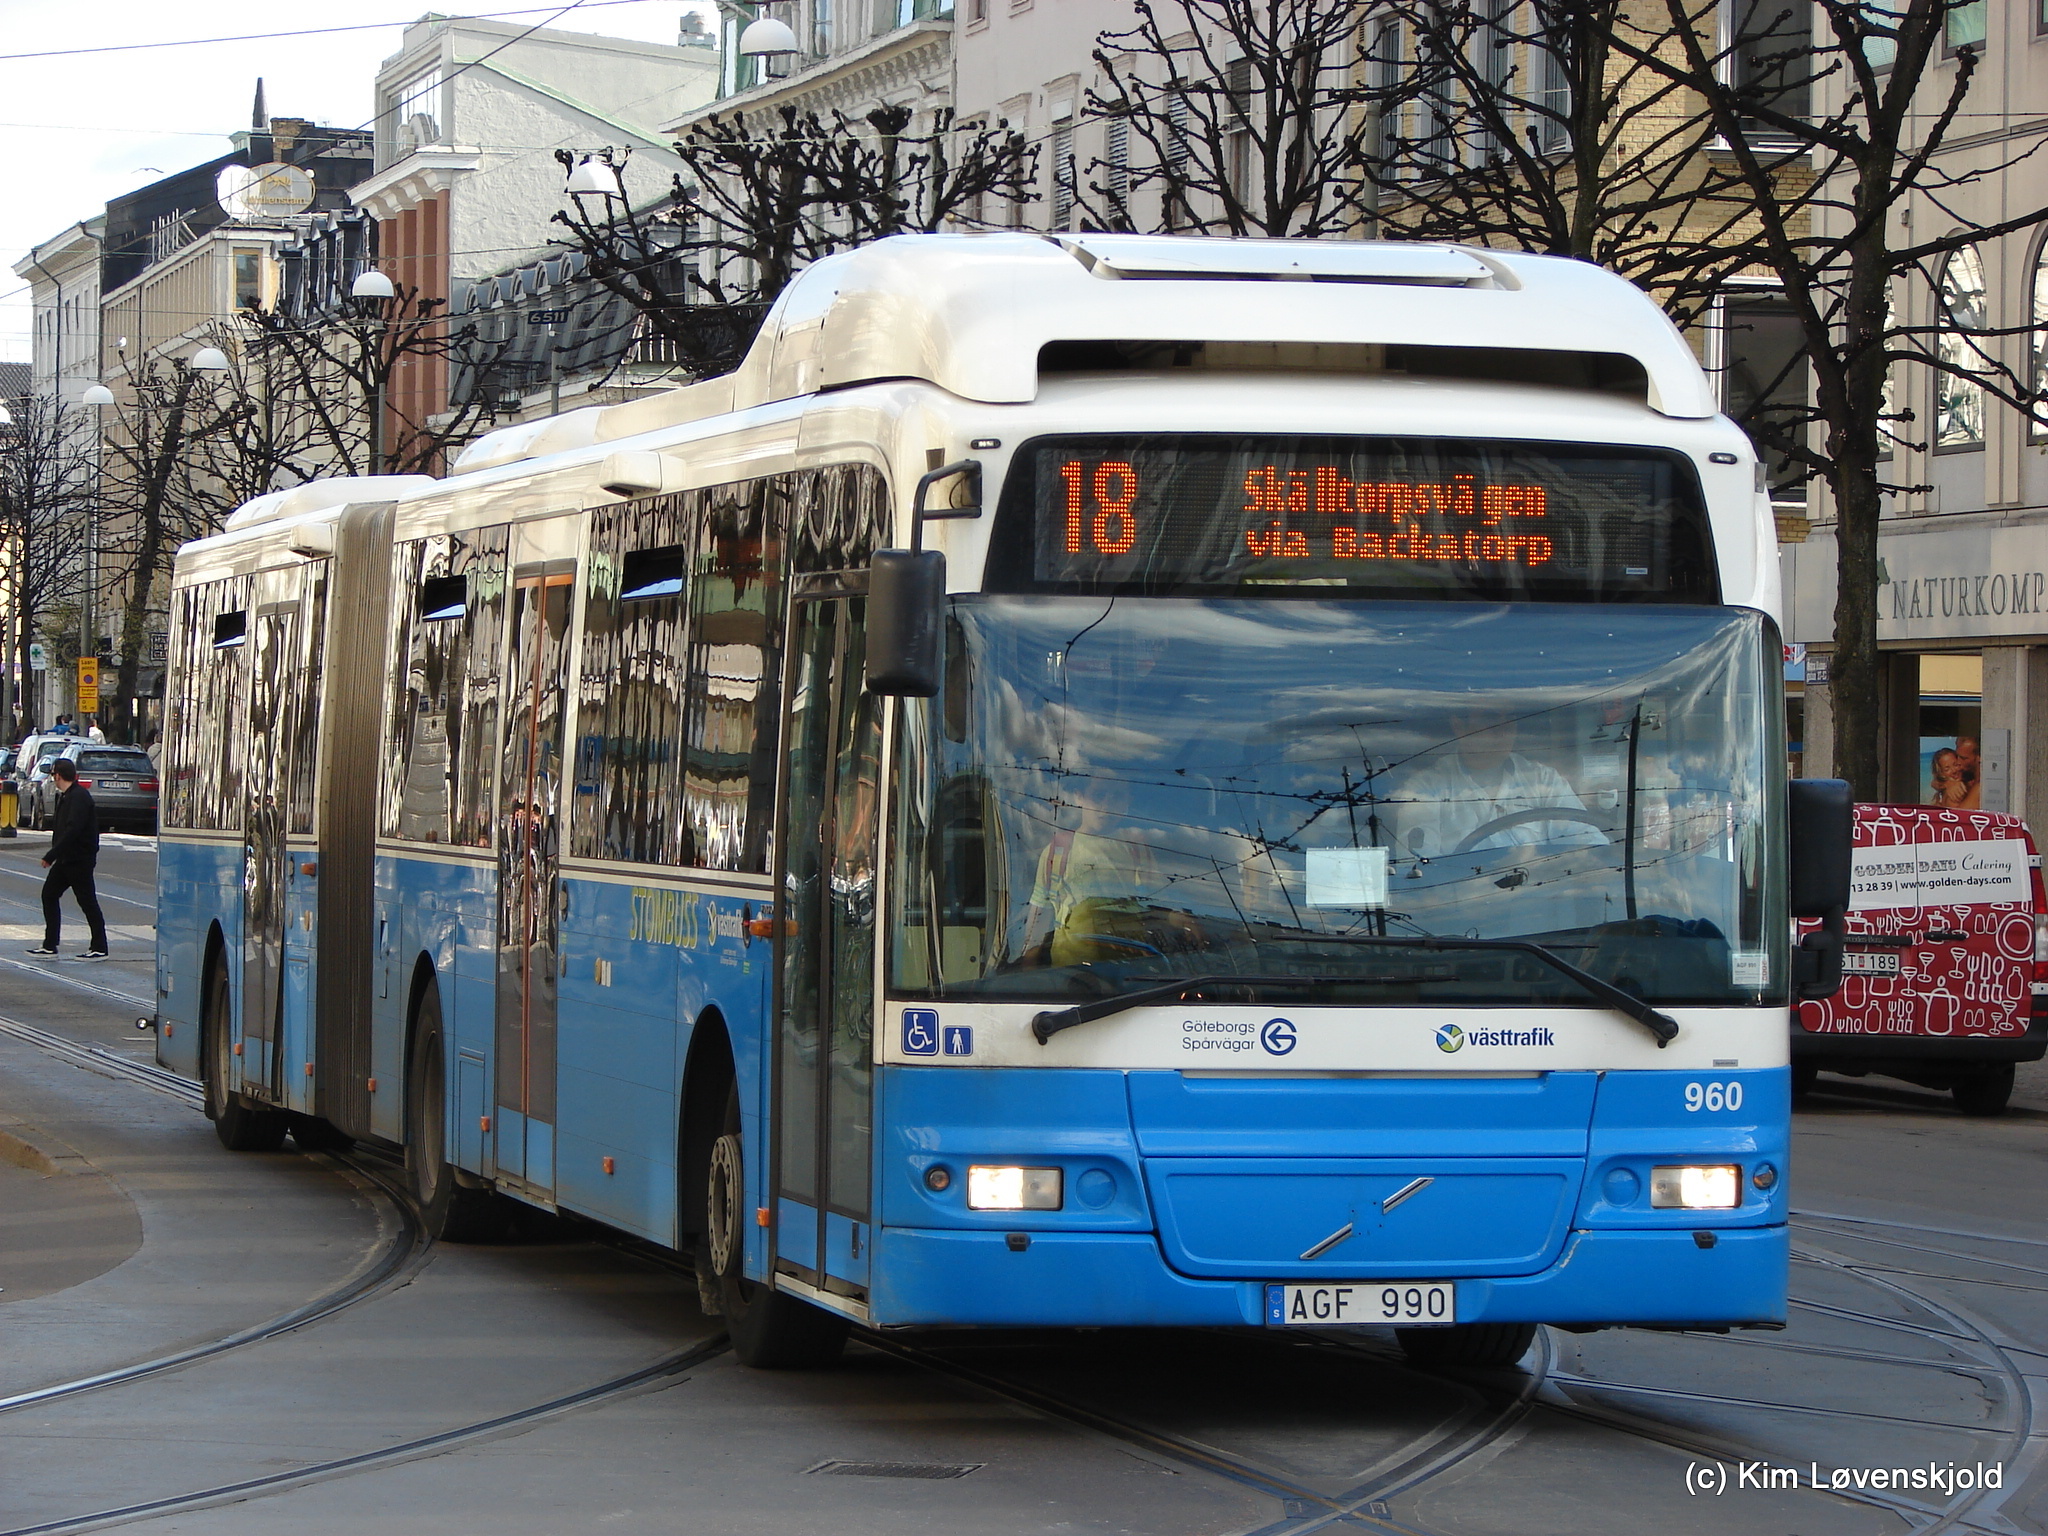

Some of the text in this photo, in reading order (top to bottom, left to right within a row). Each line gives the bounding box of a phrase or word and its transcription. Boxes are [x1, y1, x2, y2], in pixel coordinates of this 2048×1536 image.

[530, 311, 565, 322] 6511
[1061, 460, 1137, 554] 18
[1243, 465, 1547, 525] Skälltorpsvägen
[1246, 520, 1552, 566] via Backatorp
[1892, 573, 2048, 619] NATURKOMP
[1854, 853, 2012, 877] GOLDEN DAYS Catering
[1866, 882, 1879, 892] 28
[1880, 881, 1893, 891] 39
[1900, 875, 2012, 889] www.golden-days.com
[630, 886, 698, 950] STOMBUSS
[1870, 955, 1896, 969] 189
[1182, 1020, 1255, 1035] Göteborgs
[1468, 1027, 1555, 1047] västtrafik
[1182, 1037, 1255, 1052] Spårvägar
[1684, 1081, 1743, 1112] 960
[1273, 1287, 1445, 1319] S AGF 990
